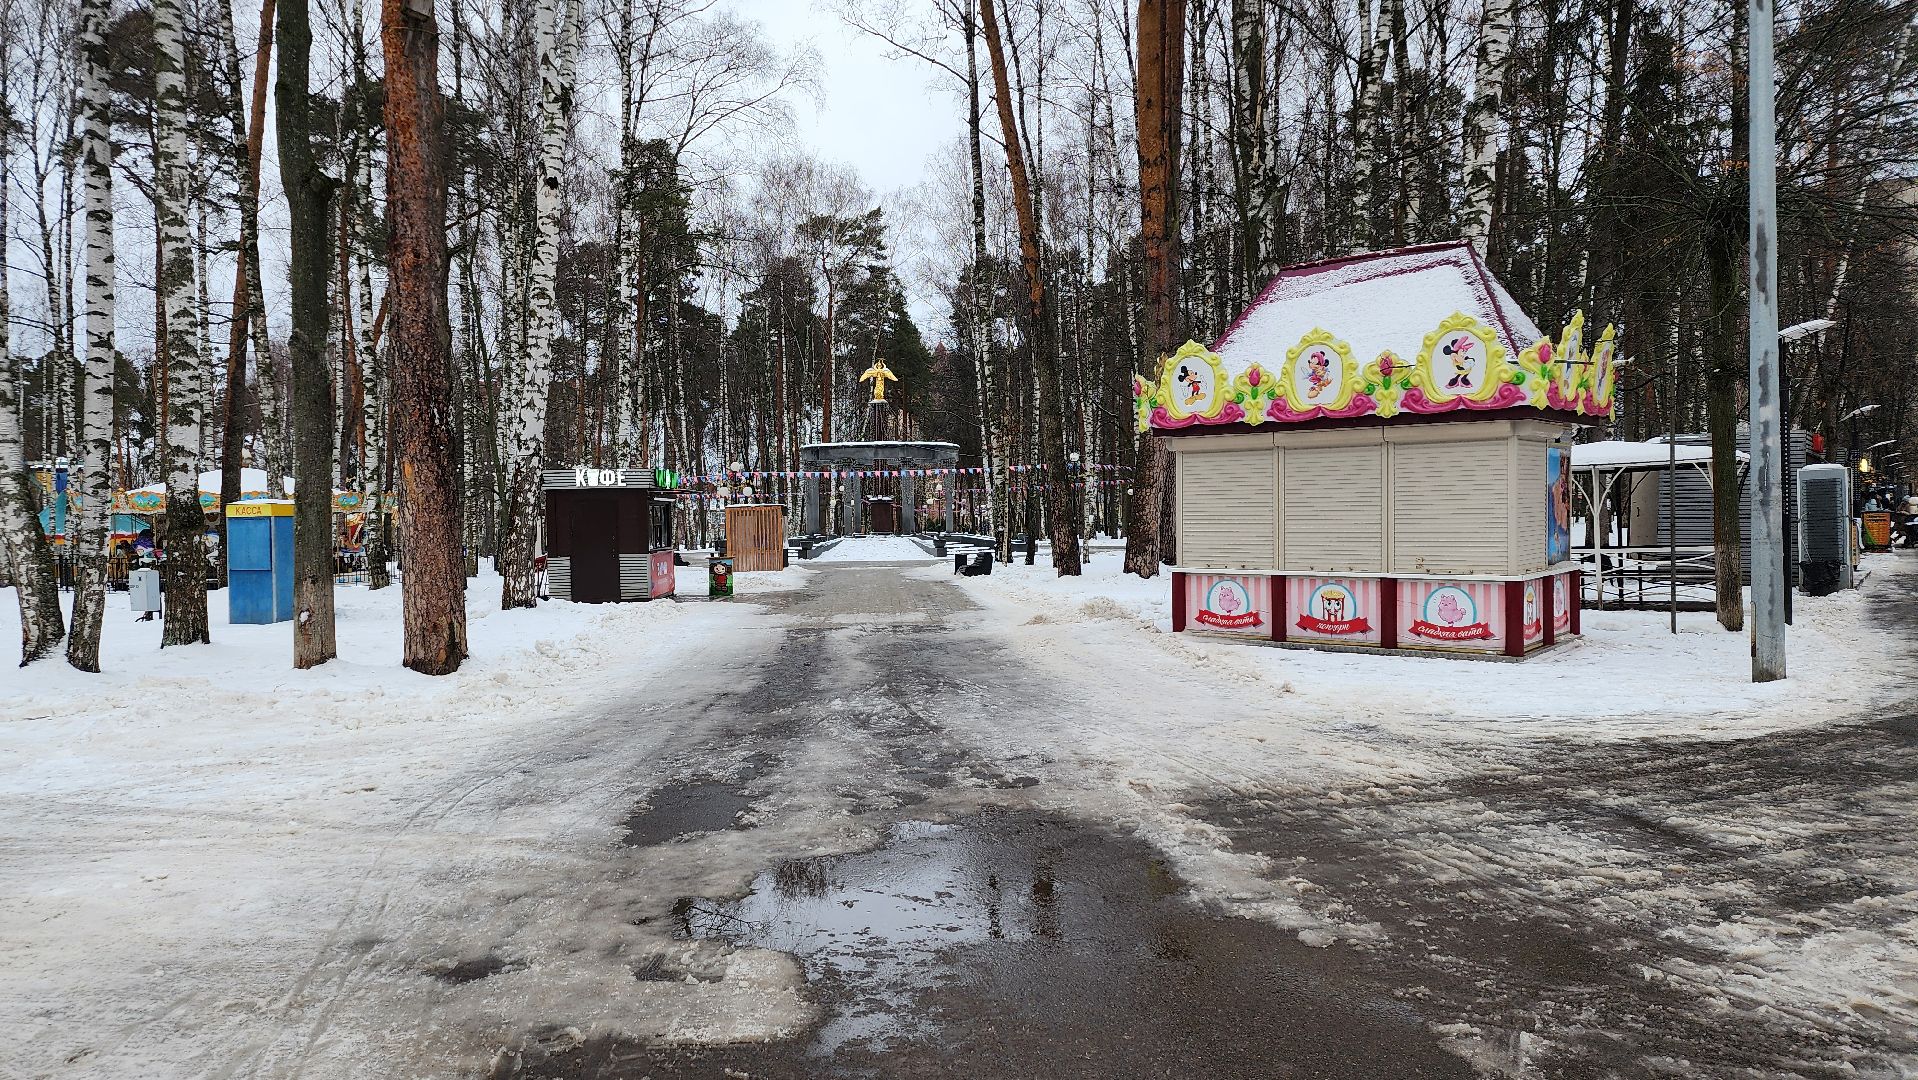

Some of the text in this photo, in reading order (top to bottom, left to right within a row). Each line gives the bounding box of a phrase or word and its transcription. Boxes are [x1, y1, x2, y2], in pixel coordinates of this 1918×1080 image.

[575, 468, 627, 487] КФЕ
[235, 506, 262, 516] КАССА
[1457, 627, 1484, 638] вата
